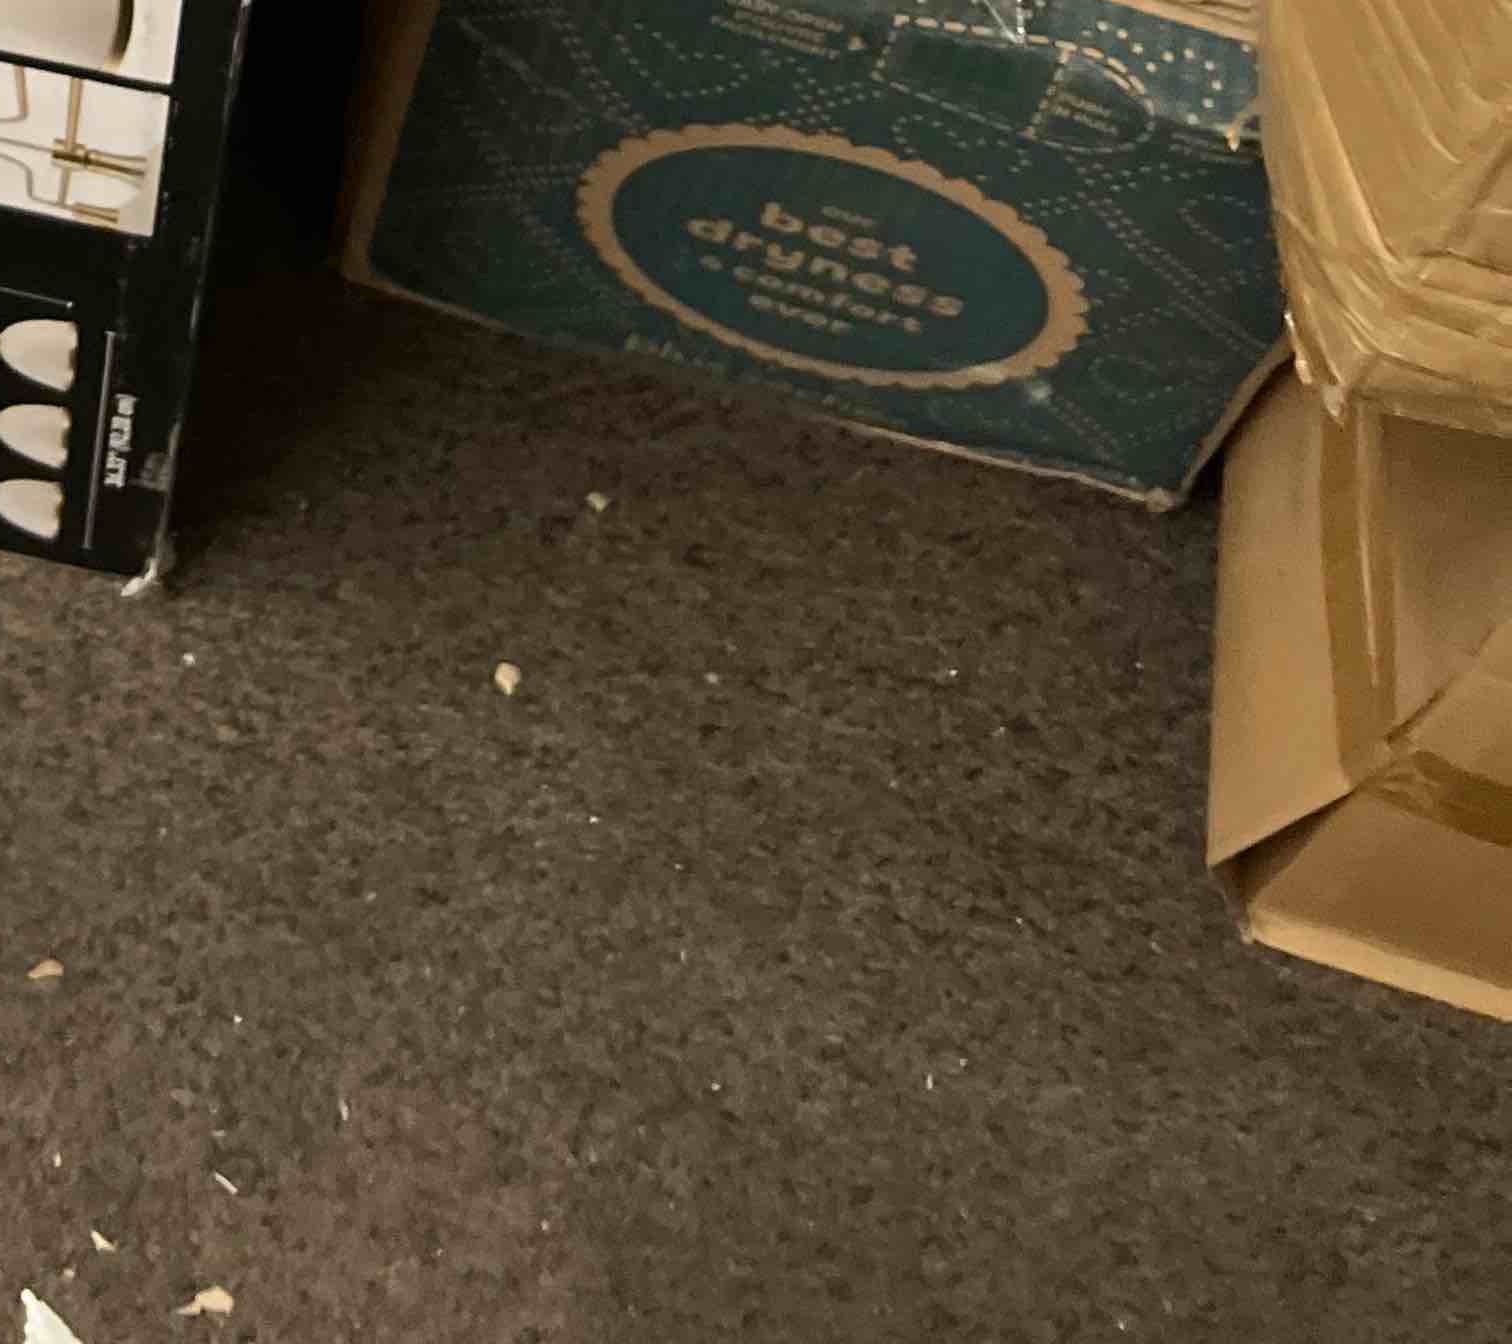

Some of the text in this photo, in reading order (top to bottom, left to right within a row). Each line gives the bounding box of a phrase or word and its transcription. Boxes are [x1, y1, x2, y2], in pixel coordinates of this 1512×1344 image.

[685, 217, 965, 319] dryness
[761, 201, 917, 272] best
[732, 264, 922, 336] comfort
[748, 294, 854, 334] ever
